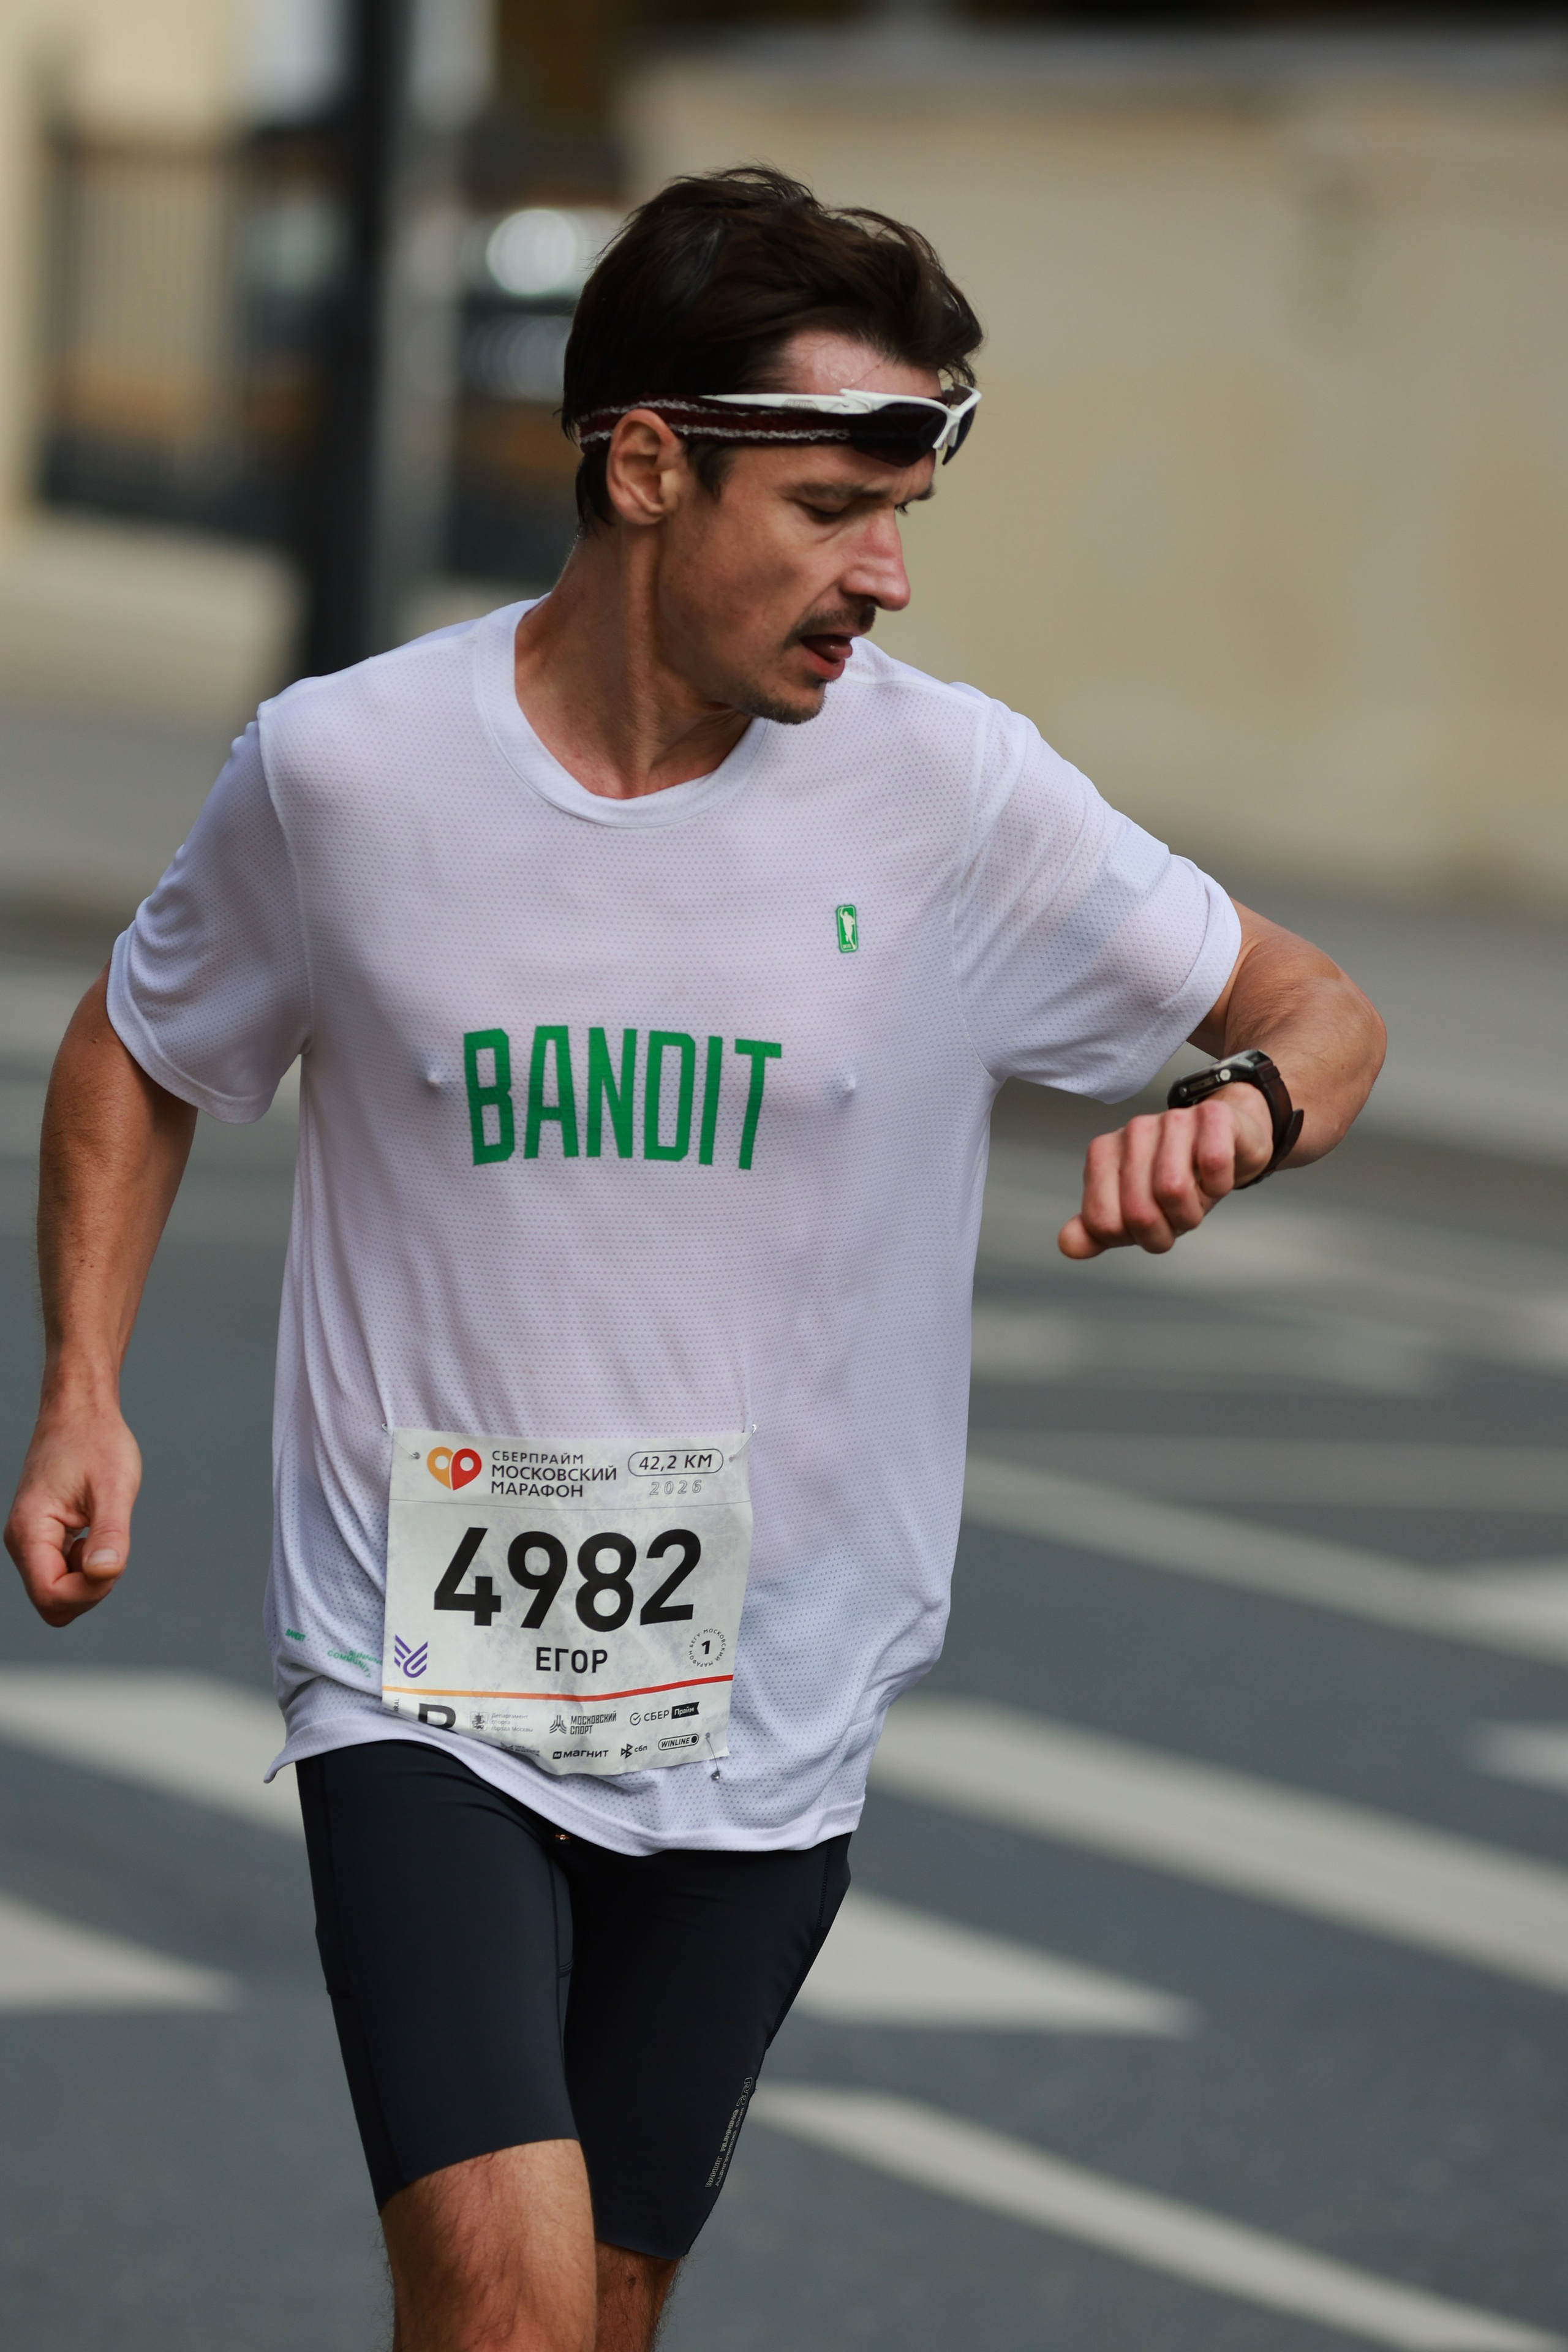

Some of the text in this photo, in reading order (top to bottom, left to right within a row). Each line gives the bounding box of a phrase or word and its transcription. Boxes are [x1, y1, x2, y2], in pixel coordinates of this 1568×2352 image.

[463, 1025, 782, 1170] BANDIT
[492, 1450, 584, 1464] СБЕРПРАЙМ
[639, 1453, 712, 1472] 42,2 КМ
[491, 1464, 617, 1481] МОСКОВСКИЙ
[491, 1481, 583, 1498] МАРАФОН
[649, 1479, 703, 1496] 2026
[434, 1527, 702, 1633] 4982
[688, 1628, 726, 1667] БЕГУ МОСКОВСКИЙ МАРАФОН
[701, 1640, 710, 1655] 1
[327, 1650, 371, 1678] COMMUNITY
[535, 1646, 608, 1674] ЕГОР
[570, 1710, 617, 1725] МОСКОВСКИЙ
[644, 1706, 695, 1722] СБЕР Прайм
[570, 1725, 593, 1735] СПОРТ
[634, 1744, 648, 1753] сбп
[661, 1737, 691, 1749] WINLINE
[704, 2109, 739, 2188] BANDIT RUNNING
